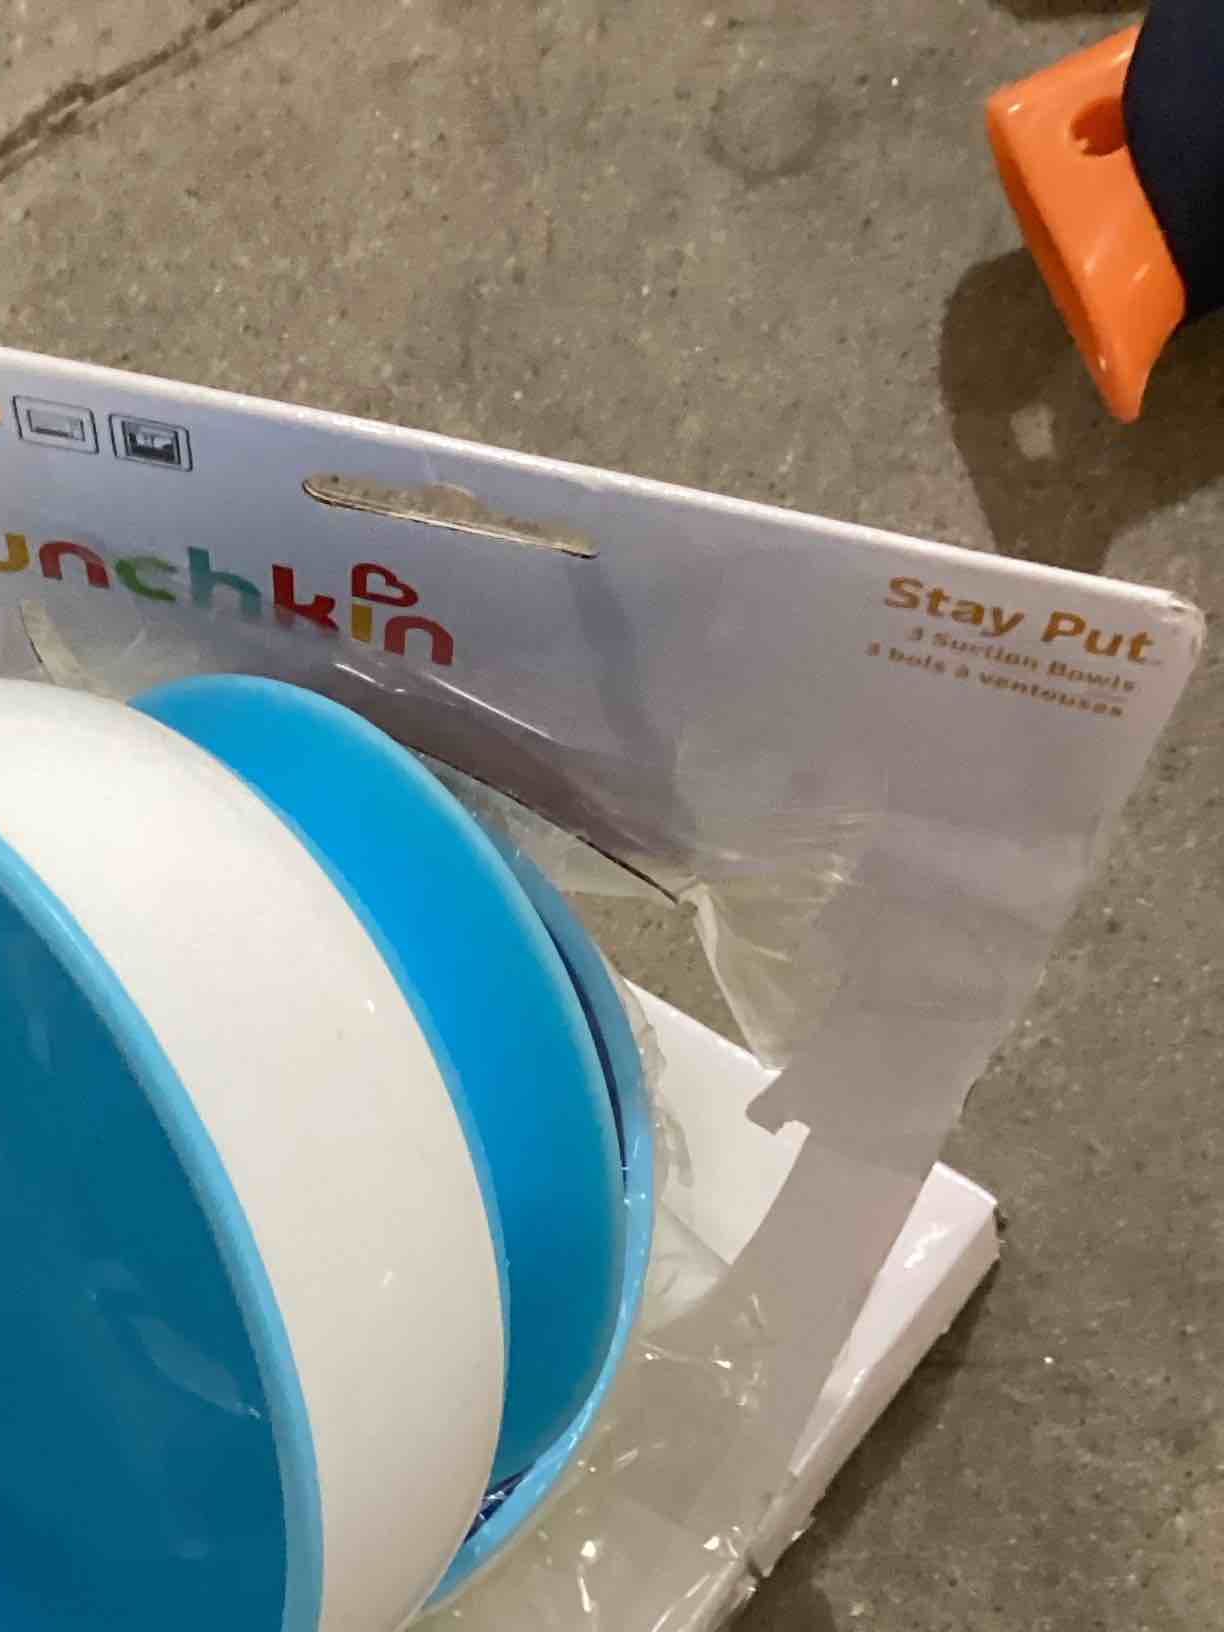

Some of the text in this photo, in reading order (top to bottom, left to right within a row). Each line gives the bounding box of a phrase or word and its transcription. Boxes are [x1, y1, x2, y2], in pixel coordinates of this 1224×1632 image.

[884, 575, 1155, 666] Stay Put
[888, 647, 946, 674] bols
[979, 671, 1124, 718] ventouses
[931, 631, 1039, 671] Suction
[1047, 660, 1137, 693] Bowls
